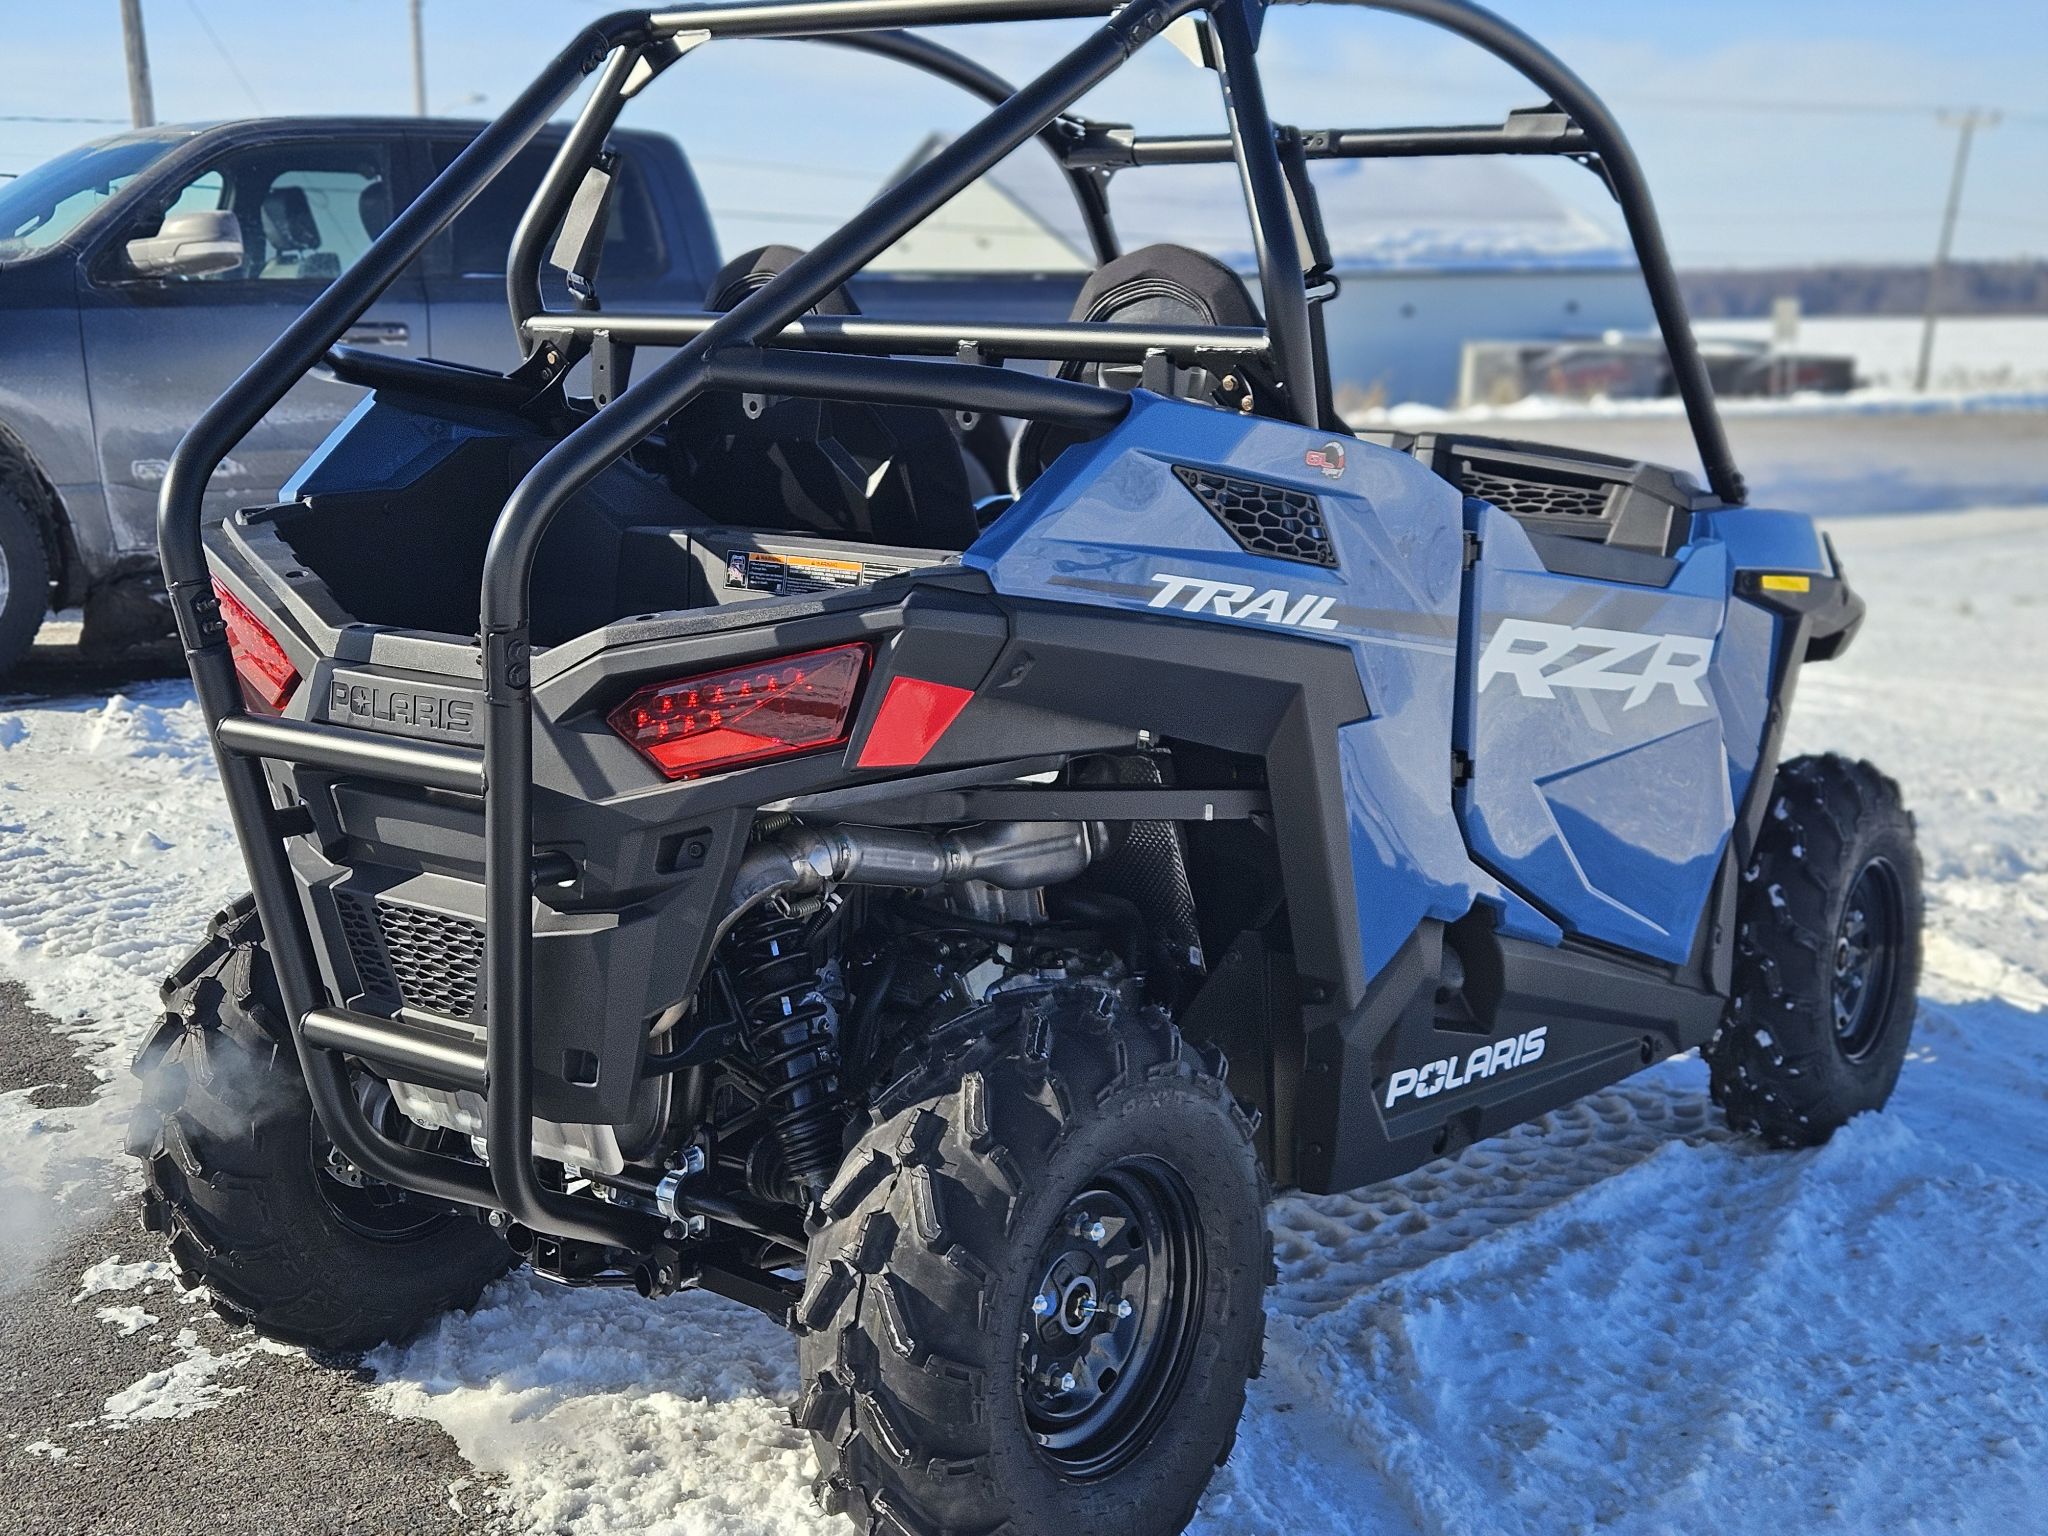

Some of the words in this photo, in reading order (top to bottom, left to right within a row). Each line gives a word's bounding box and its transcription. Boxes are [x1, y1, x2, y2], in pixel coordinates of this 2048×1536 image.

[1147, 573, 1340, 630] TRAIL
[1478, 618, 1715, 712] RZR
[330, 680, 474, 733] POLARIS
[1385, 1026, 1548, 1108] POLARIS
